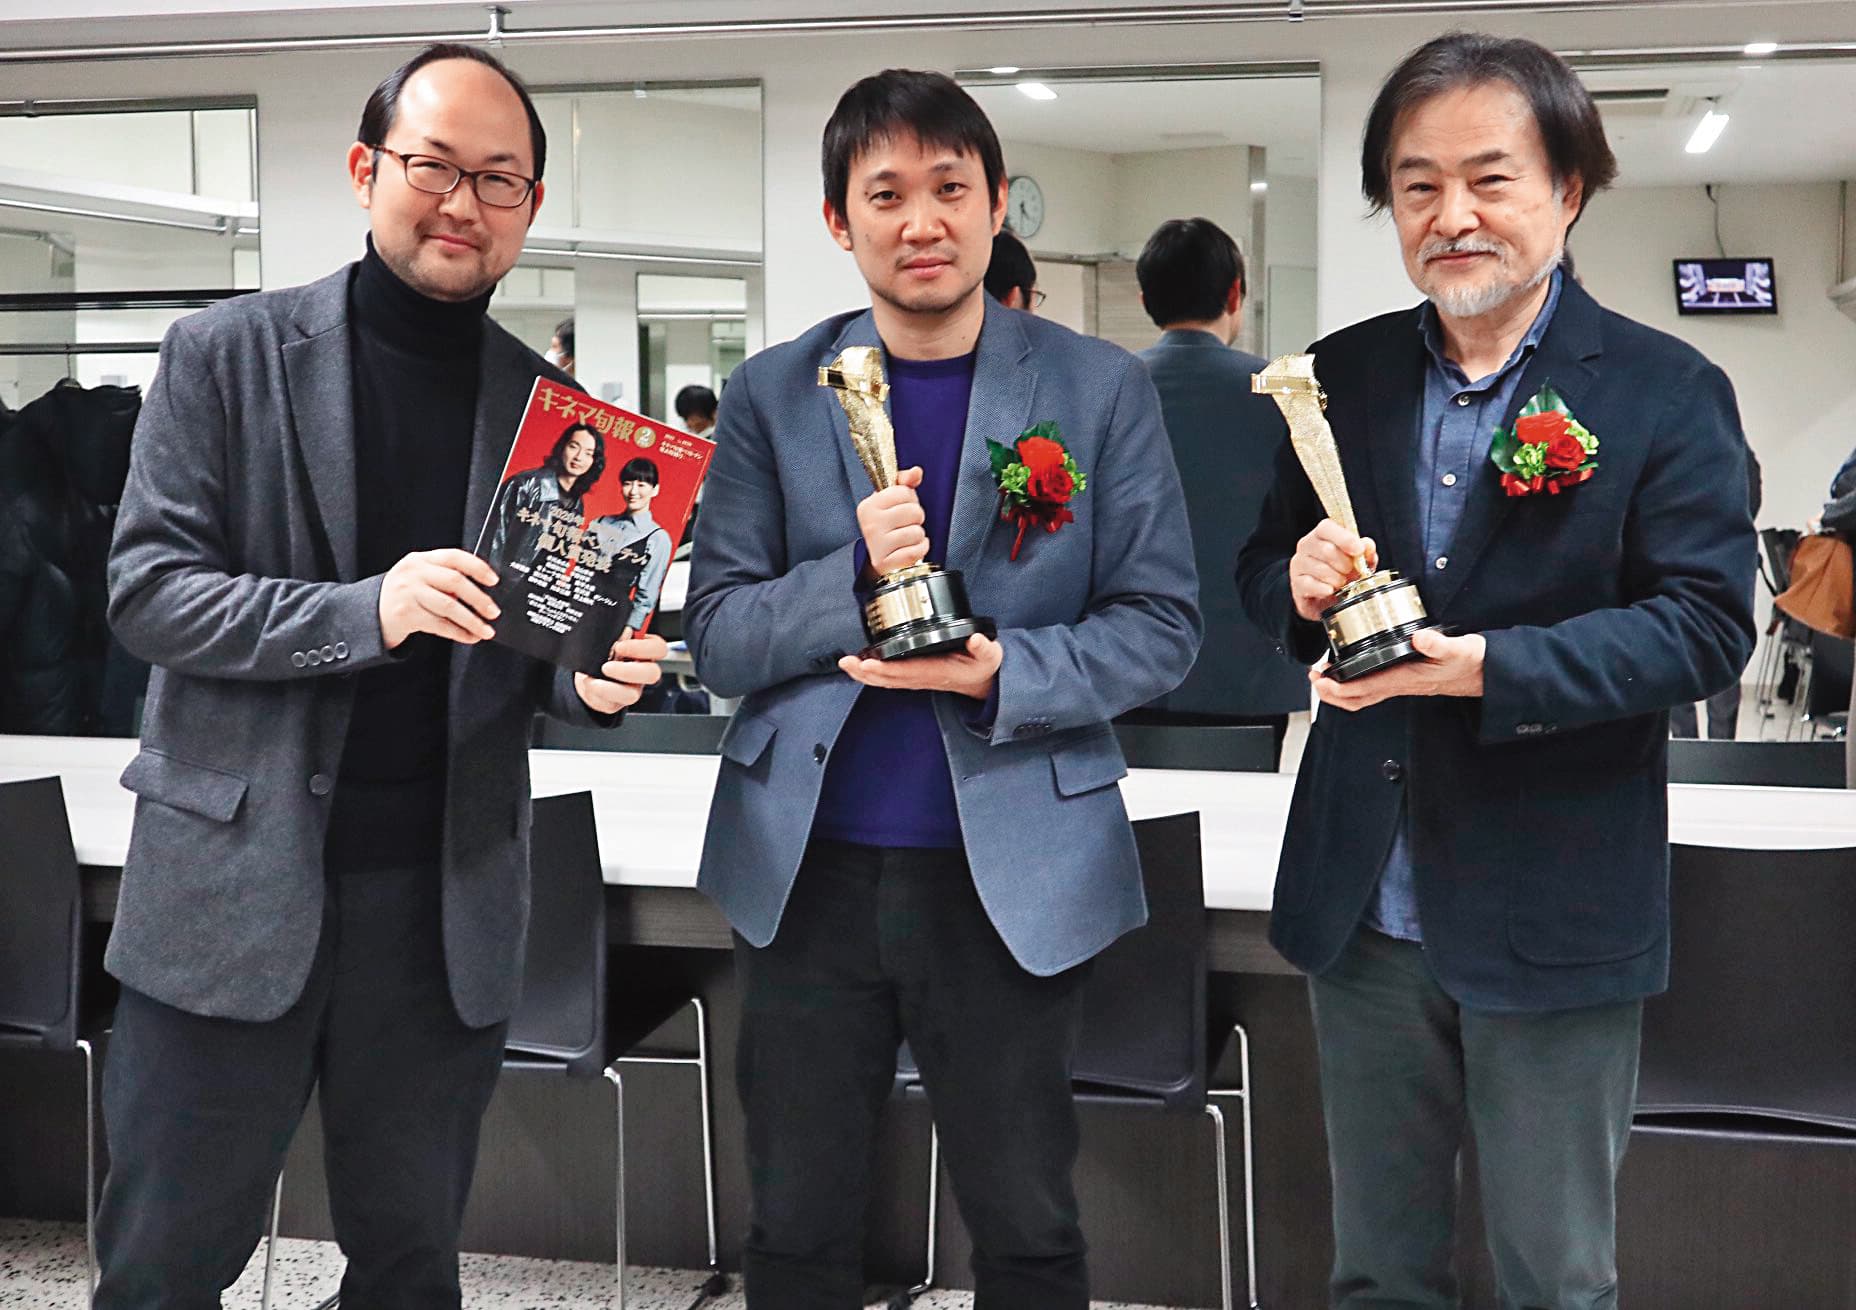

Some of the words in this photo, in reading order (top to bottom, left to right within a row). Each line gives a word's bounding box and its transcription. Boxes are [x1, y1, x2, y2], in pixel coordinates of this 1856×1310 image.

[538, 387, 637, 443] キネマ旬報
